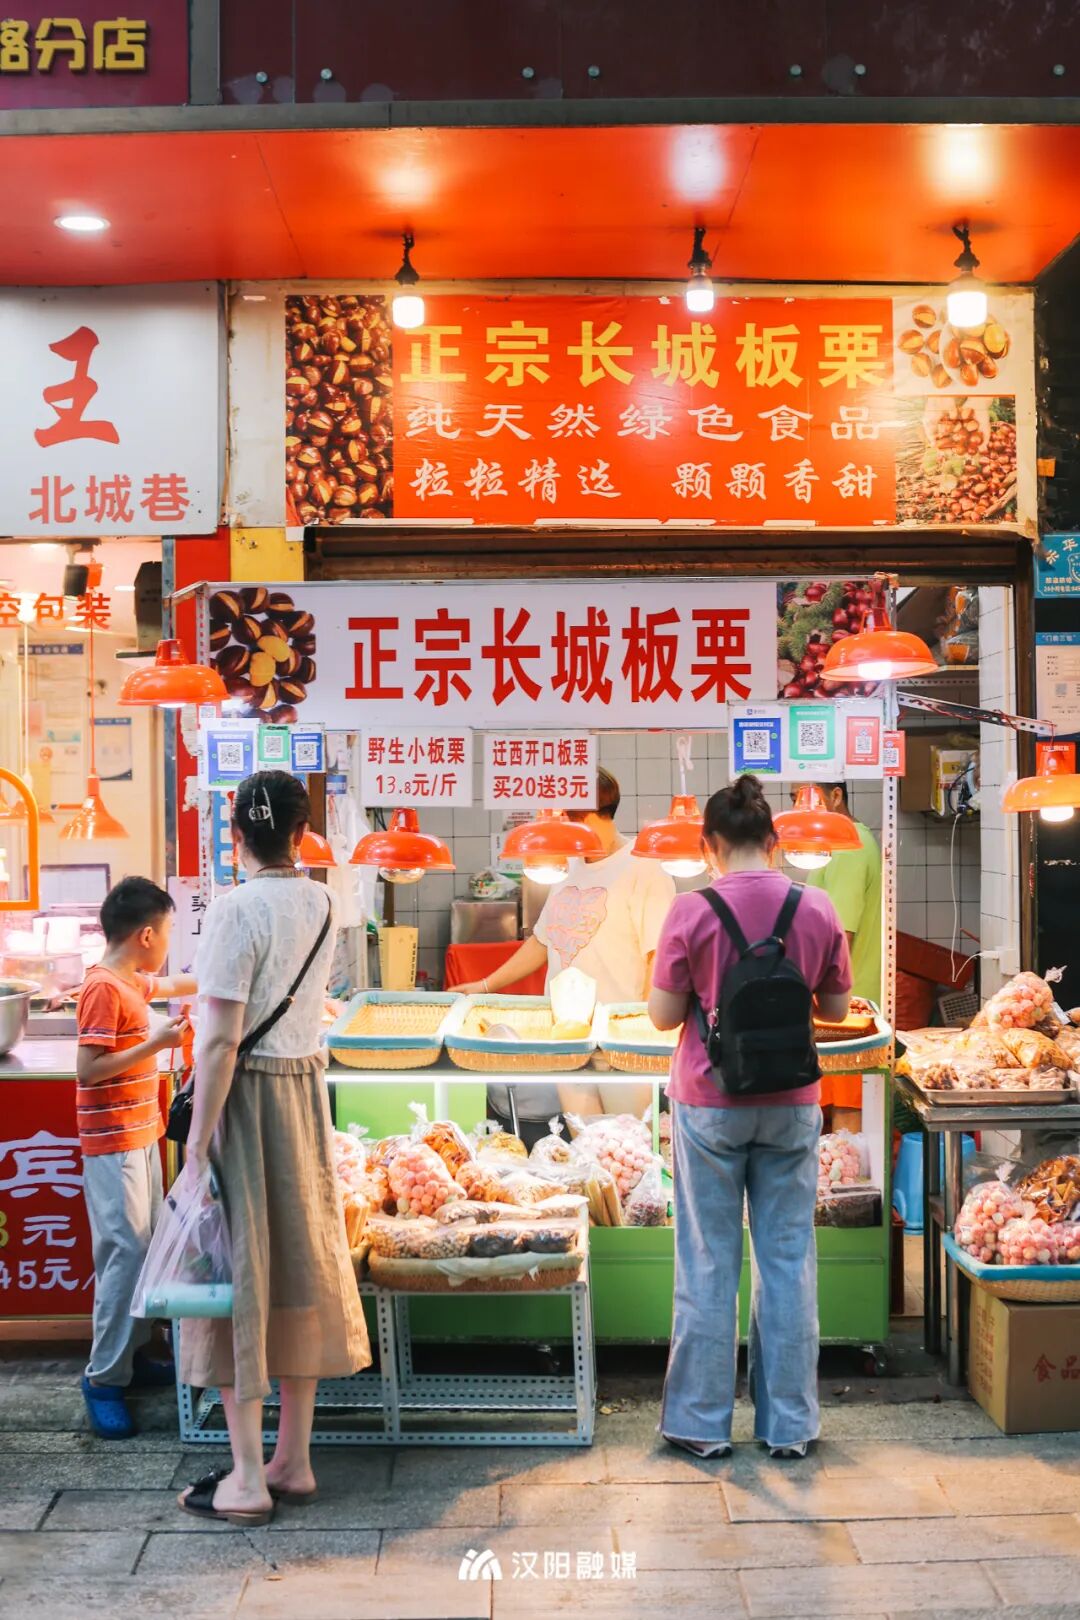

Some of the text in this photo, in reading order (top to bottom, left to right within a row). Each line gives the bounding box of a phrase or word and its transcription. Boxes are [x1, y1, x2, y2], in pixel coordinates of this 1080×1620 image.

[400, 320, 886, 388] 正宗长城板栗
[34, 326, 120, 448] 王
[405, 403, 881, 441] 纯天然绿色食品
[28, 473, 189, 525] 北城巷
[409, 457, 878, 504] 粒粒精选 颗颗香甜
[345, 607, 752, 706] 正宗长城板栗
[367, 737, 465, 764] 野生小板栗
[492, 739, 588, 766] 迁西开口板栗
[375, 773, 457, 797] 13.8元/斤
[493, 775, 589, 799] 买20送3元
